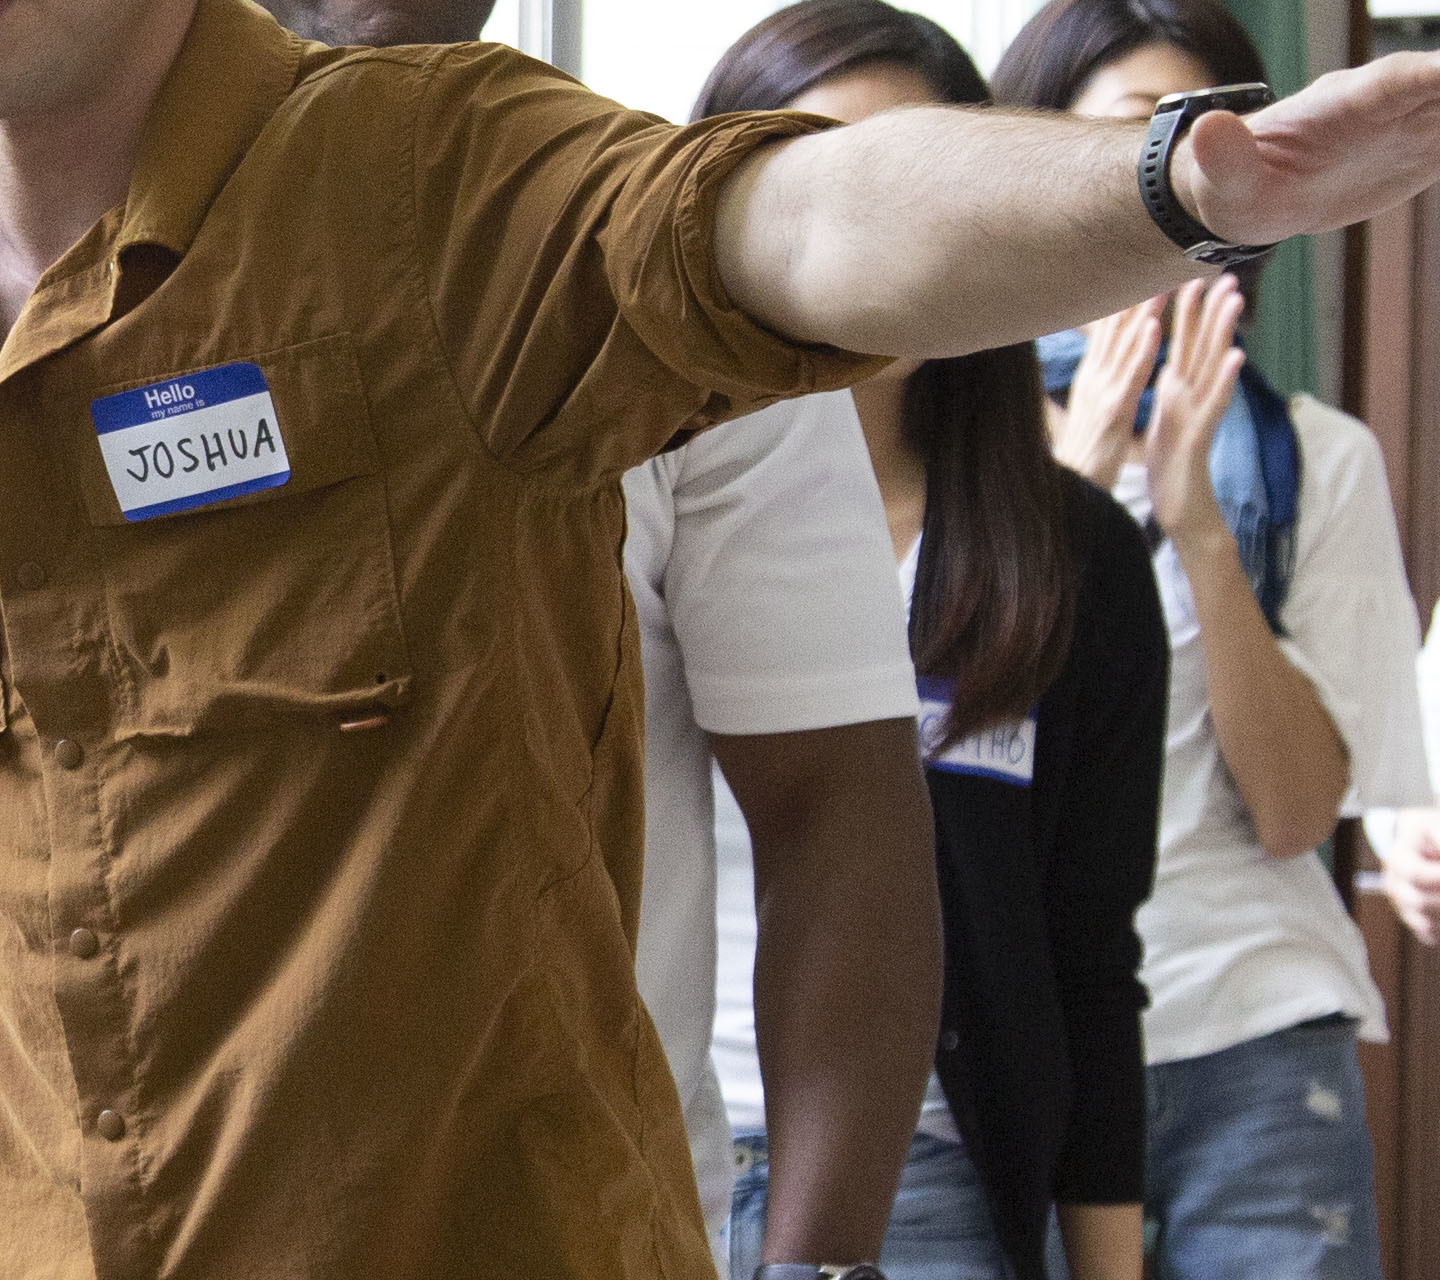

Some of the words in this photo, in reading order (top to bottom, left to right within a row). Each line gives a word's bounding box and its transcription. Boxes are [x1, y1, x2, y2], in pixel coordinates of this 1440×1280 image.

[144, 383, 195, 410] Hello
[151, 408, 166, 421] my
[167, 401, 194, 415] name
[196, 399, 205, 408] is
[126, 418, 276, 483] JOSHUA
